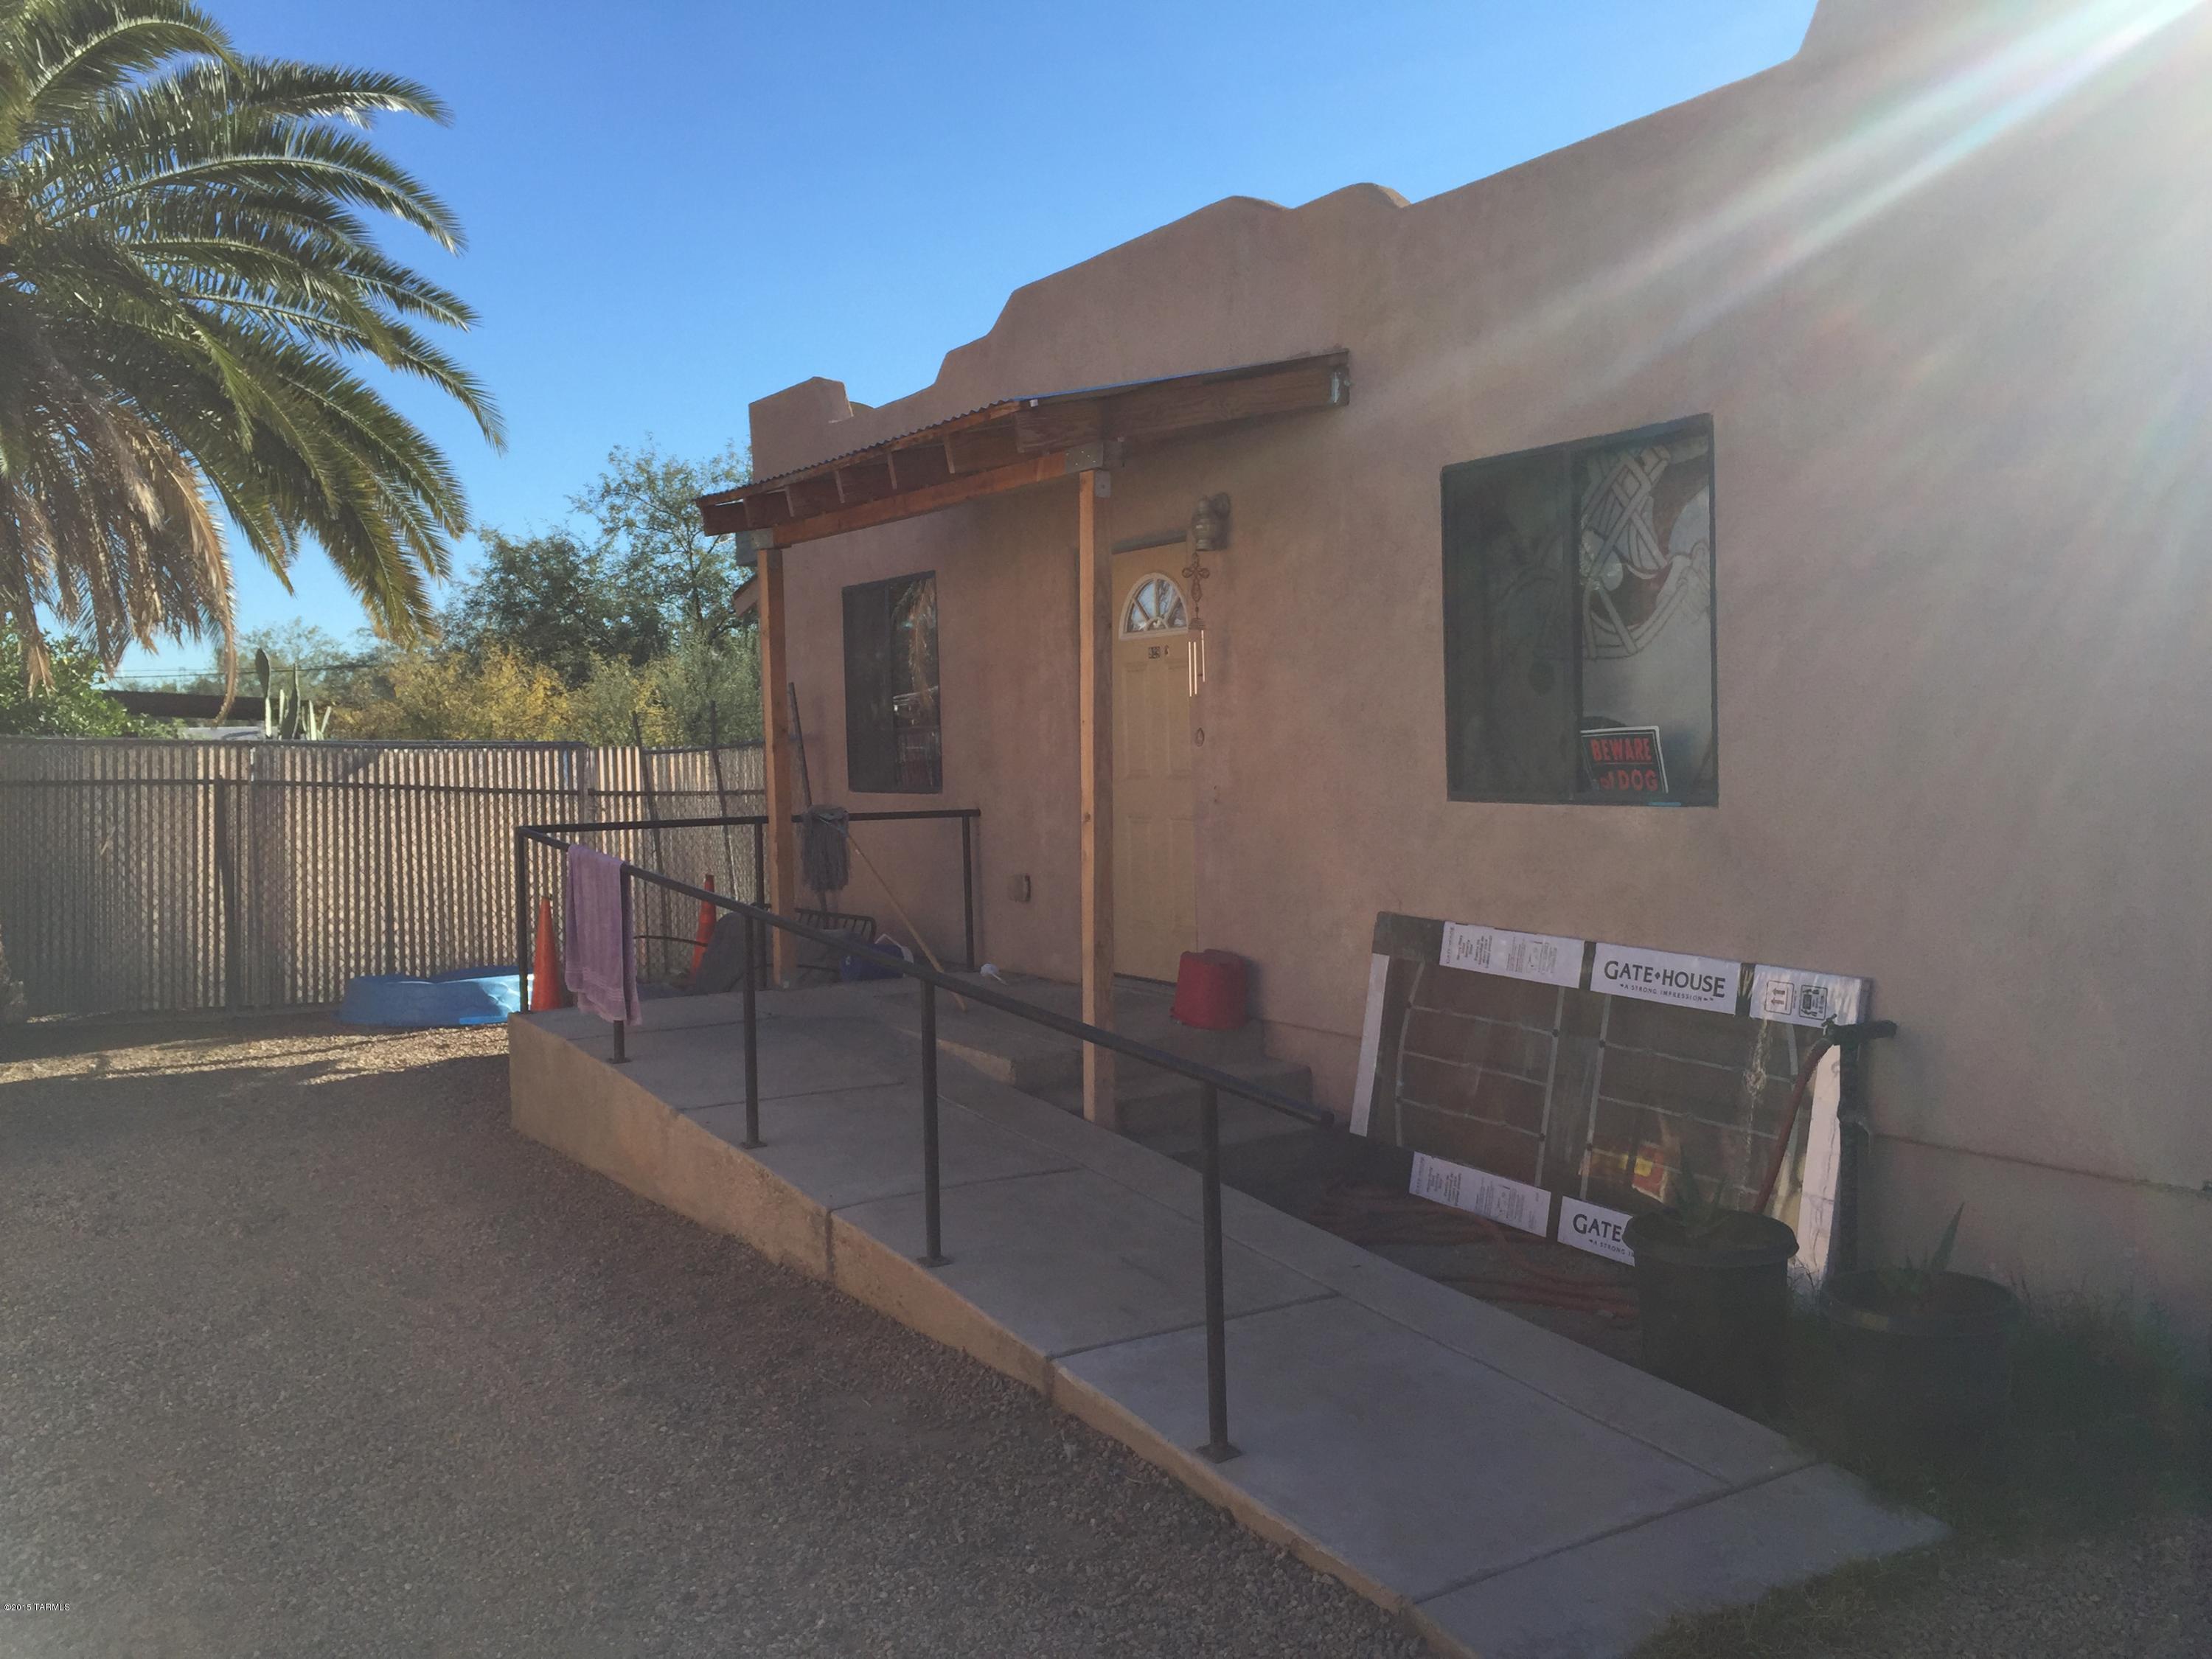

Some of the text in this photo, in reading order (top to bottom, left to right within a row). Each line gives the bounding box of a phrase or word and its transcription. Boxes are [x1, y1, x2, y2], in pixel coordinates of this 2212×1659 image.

[1591, 738, 1652, 761] BEWARE
[1617, 769, 1658, 791] DOG
[1631, 985, 1657, 995] STRONG
[1660, 990, 1703, 1001] IMPRESSION
[1573, 1214, 1622, 1242] GATE
[1599, 1242, 1625, 1255] STRONG
